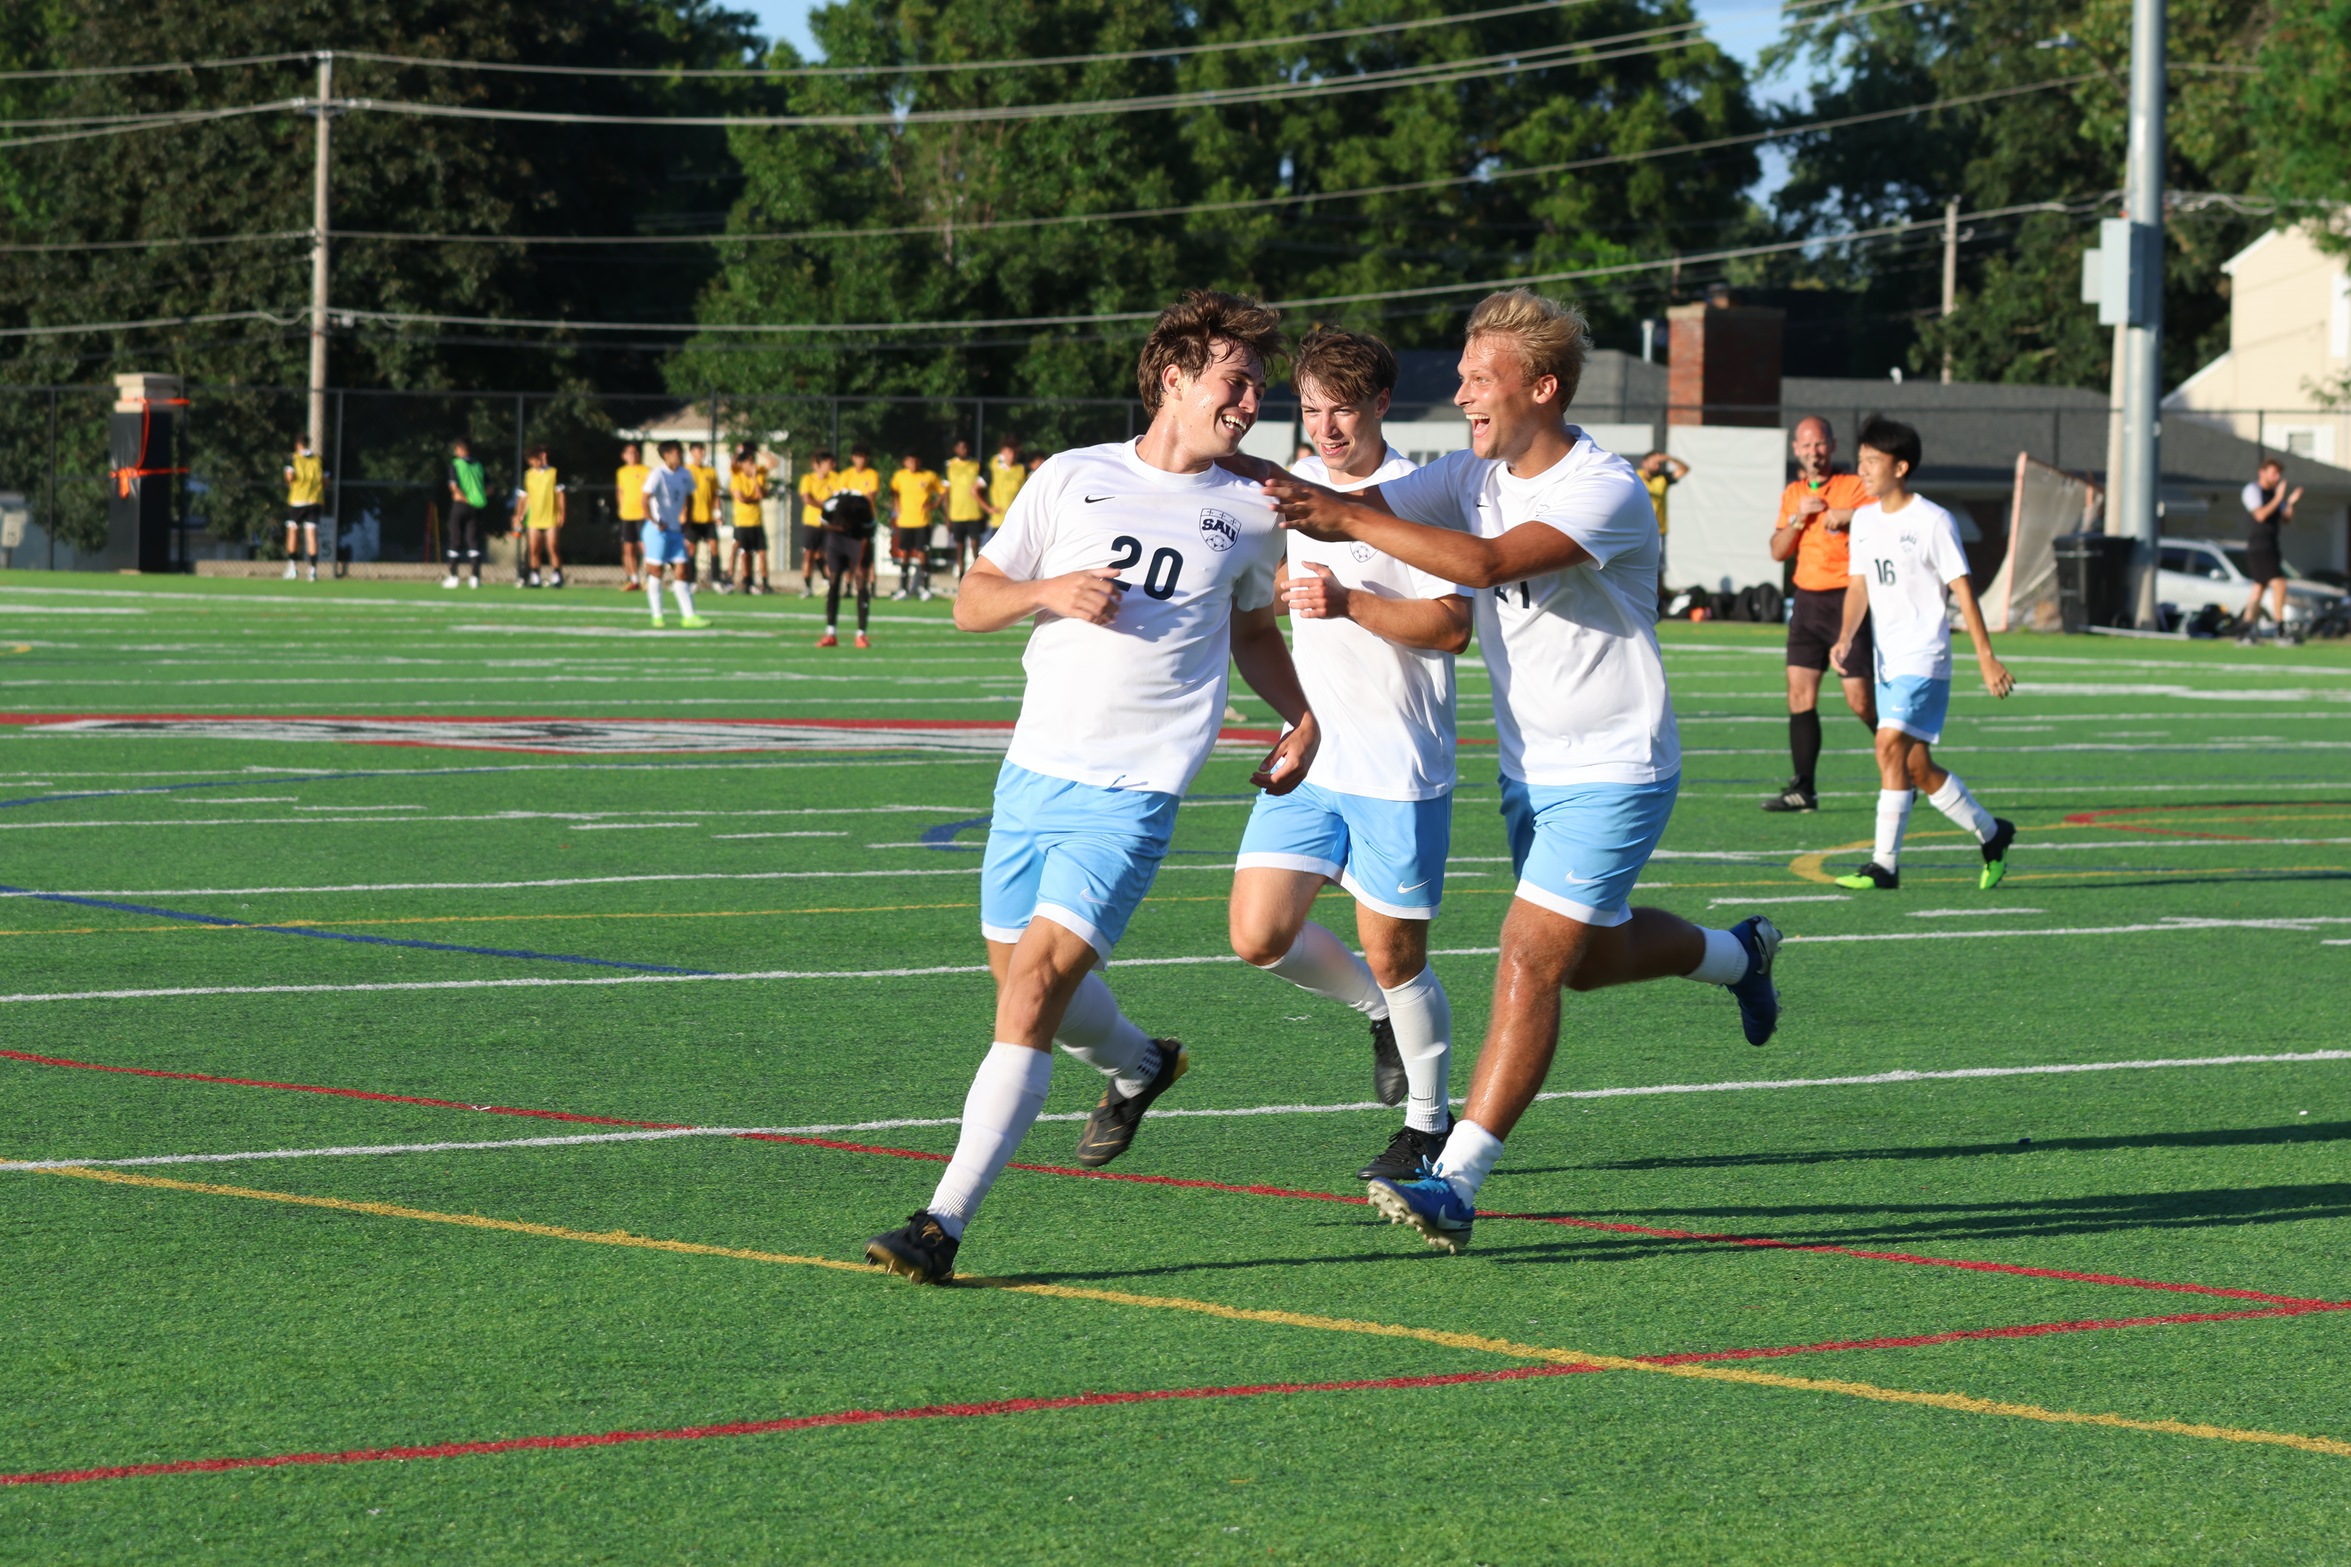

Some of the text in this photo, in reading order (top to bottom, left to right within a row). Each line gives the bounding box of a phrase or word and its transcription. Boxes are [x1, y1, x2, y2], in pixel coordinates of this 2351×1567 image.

[1202, 518, 1236, 542] SAU
[1107, 535, 1184, 601] 20
[1874, 558, 1896, 586] 16
